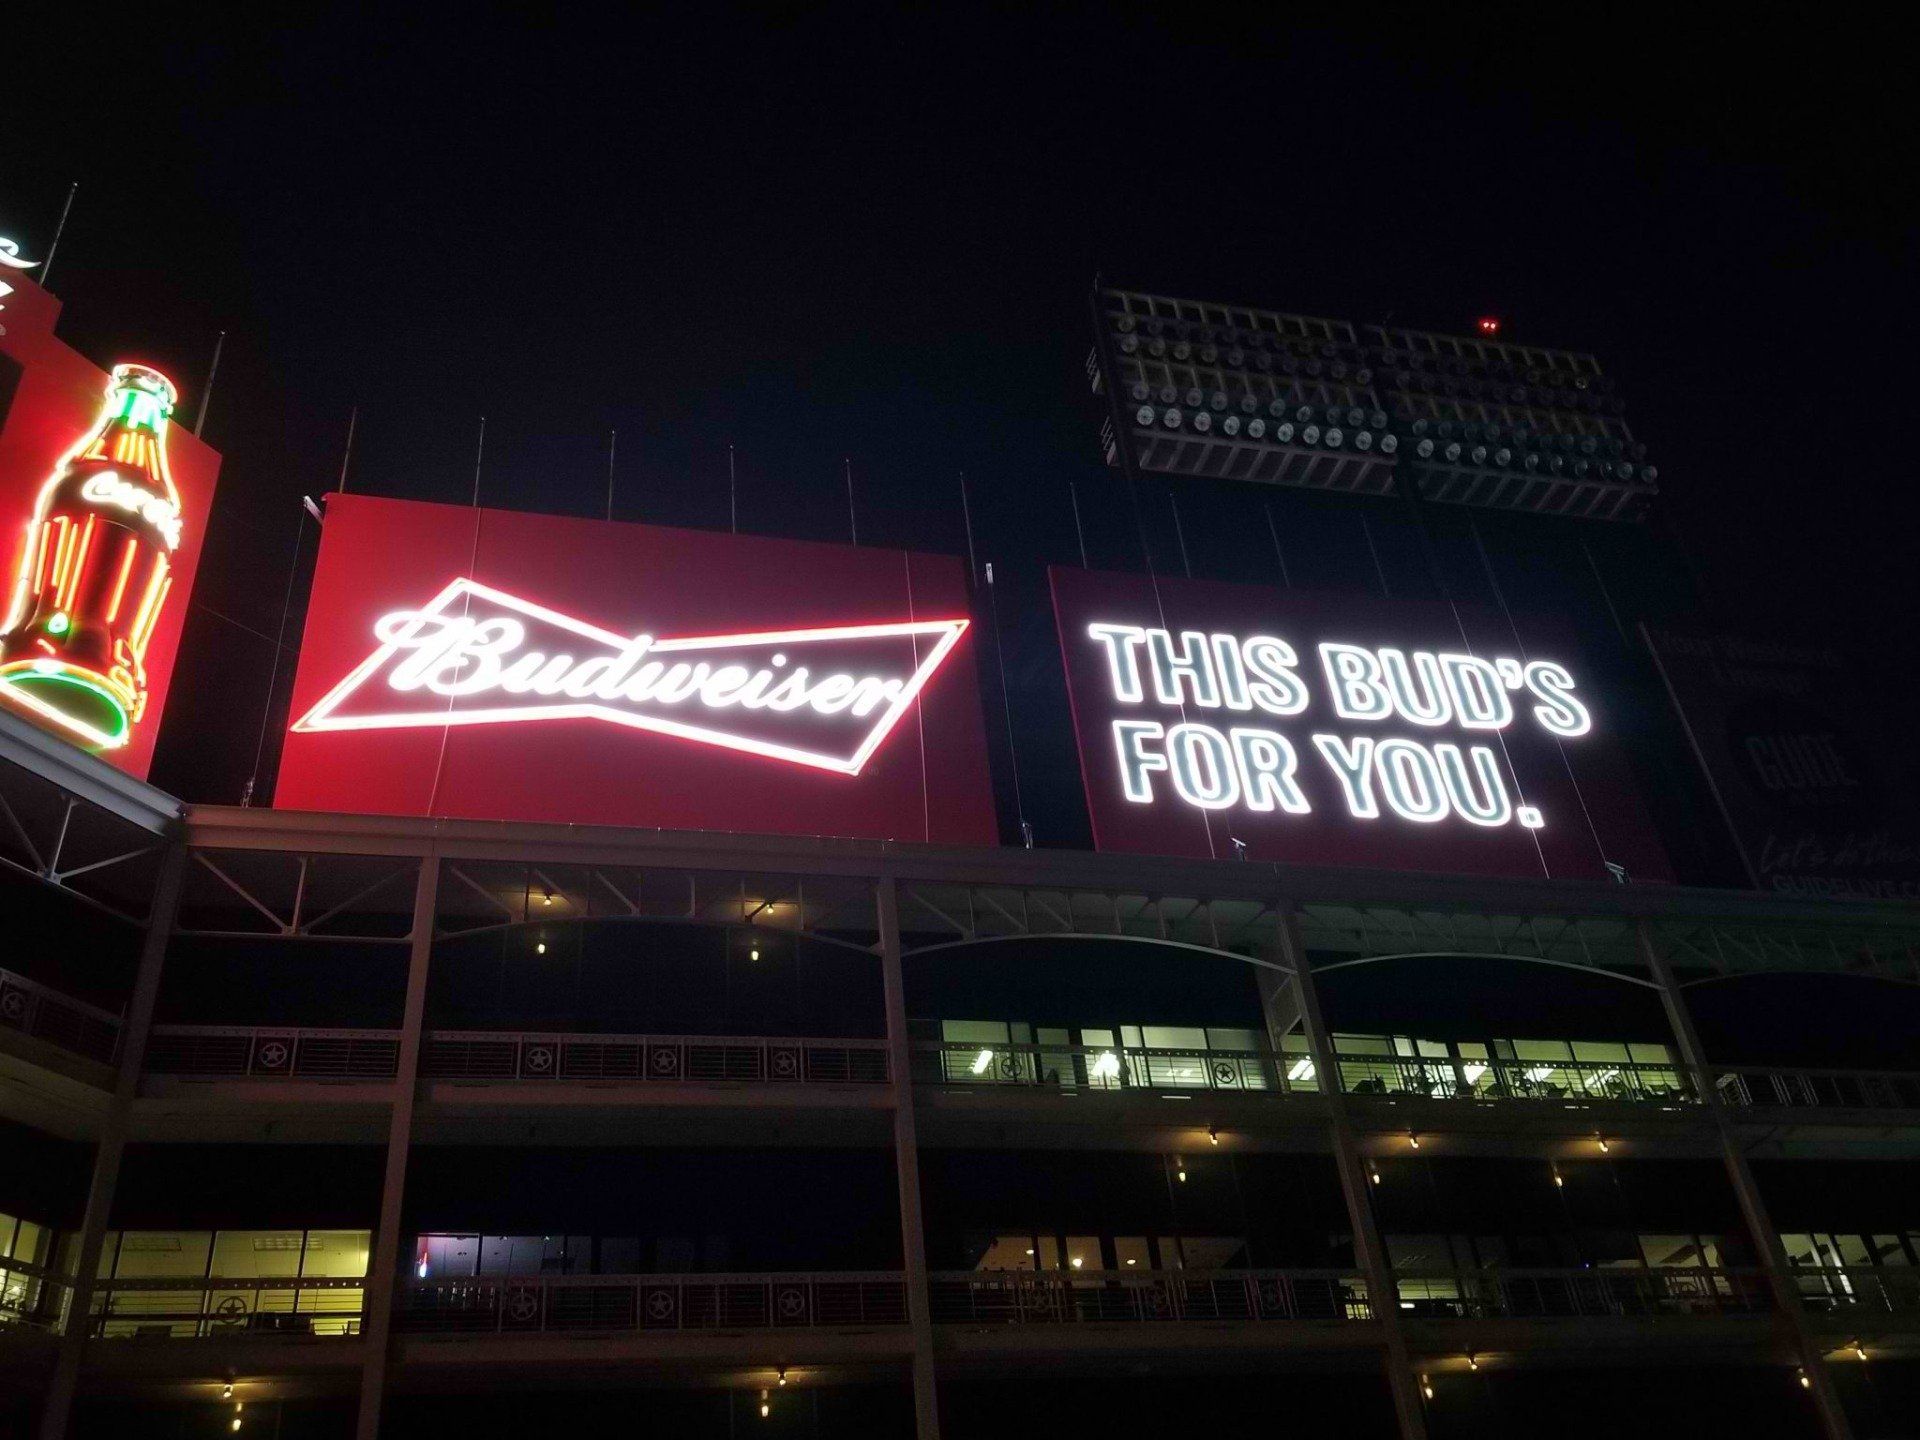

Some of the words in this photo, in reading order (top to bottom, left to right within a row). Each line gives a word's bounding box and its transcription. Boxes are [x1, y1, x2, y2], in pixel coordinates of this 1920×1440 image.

[374, 607, 915, 718] Budweiser
[1089, 622, 1309, 716] THIS
[1318, 641, 1592, 736] BUD'S
[1112, 719, 1312, 813] FOR
[1312, 733, 1545, 829] YOU.
